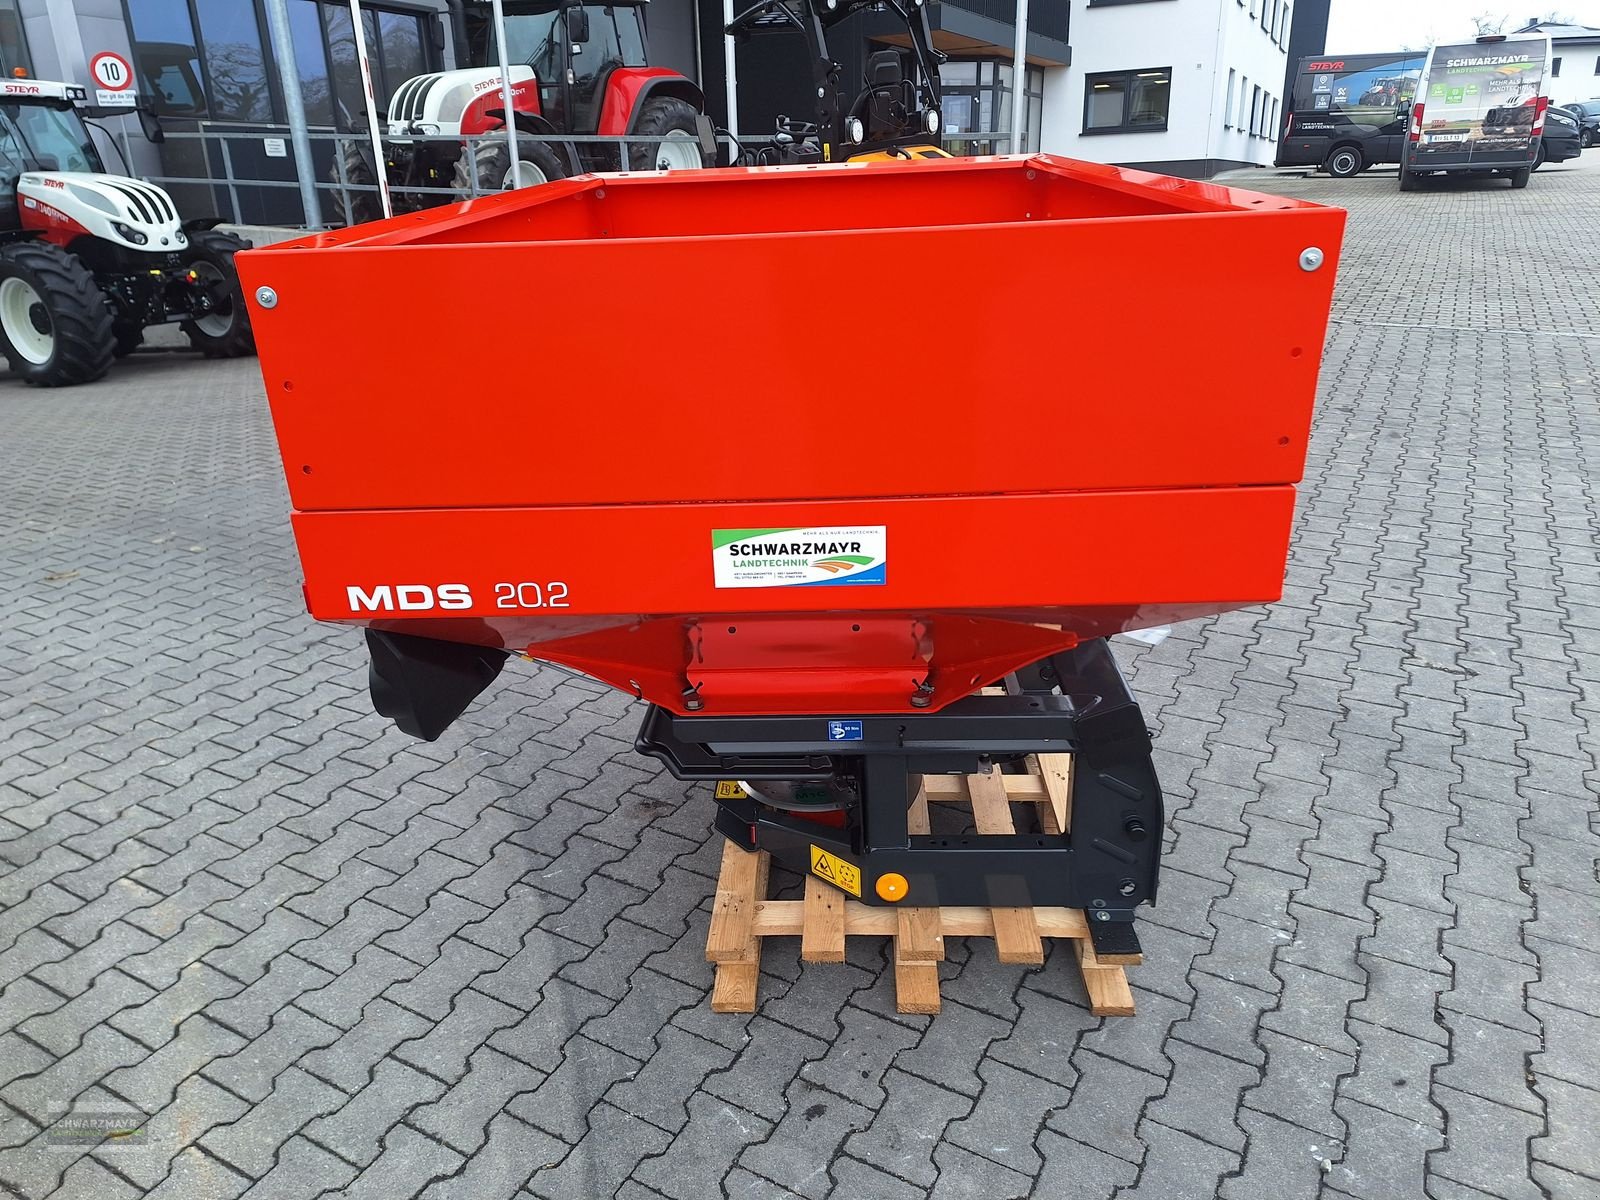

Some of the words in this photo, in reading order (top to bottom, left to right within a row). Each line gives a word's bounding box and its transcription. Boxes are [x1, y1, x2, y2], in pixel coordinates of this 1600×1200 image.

[1308, 61, 1345, 71] STEYR
[1446, 54, 1529, 68] SCHWARZMAYR
[102, 62, 120, 81] 10
[5, 85, 39, 94] STEYR
[474, 78, 496, 92] STEYR
[43, 178, 65, 189] STEYR
[729, 541, 861, 556] SCHWARZMAYR
[733, 558, 809, 568] LANDTECHNIK
[346, 583, 473, 611] MDS
[494, 581, 570, 609] 20.2
